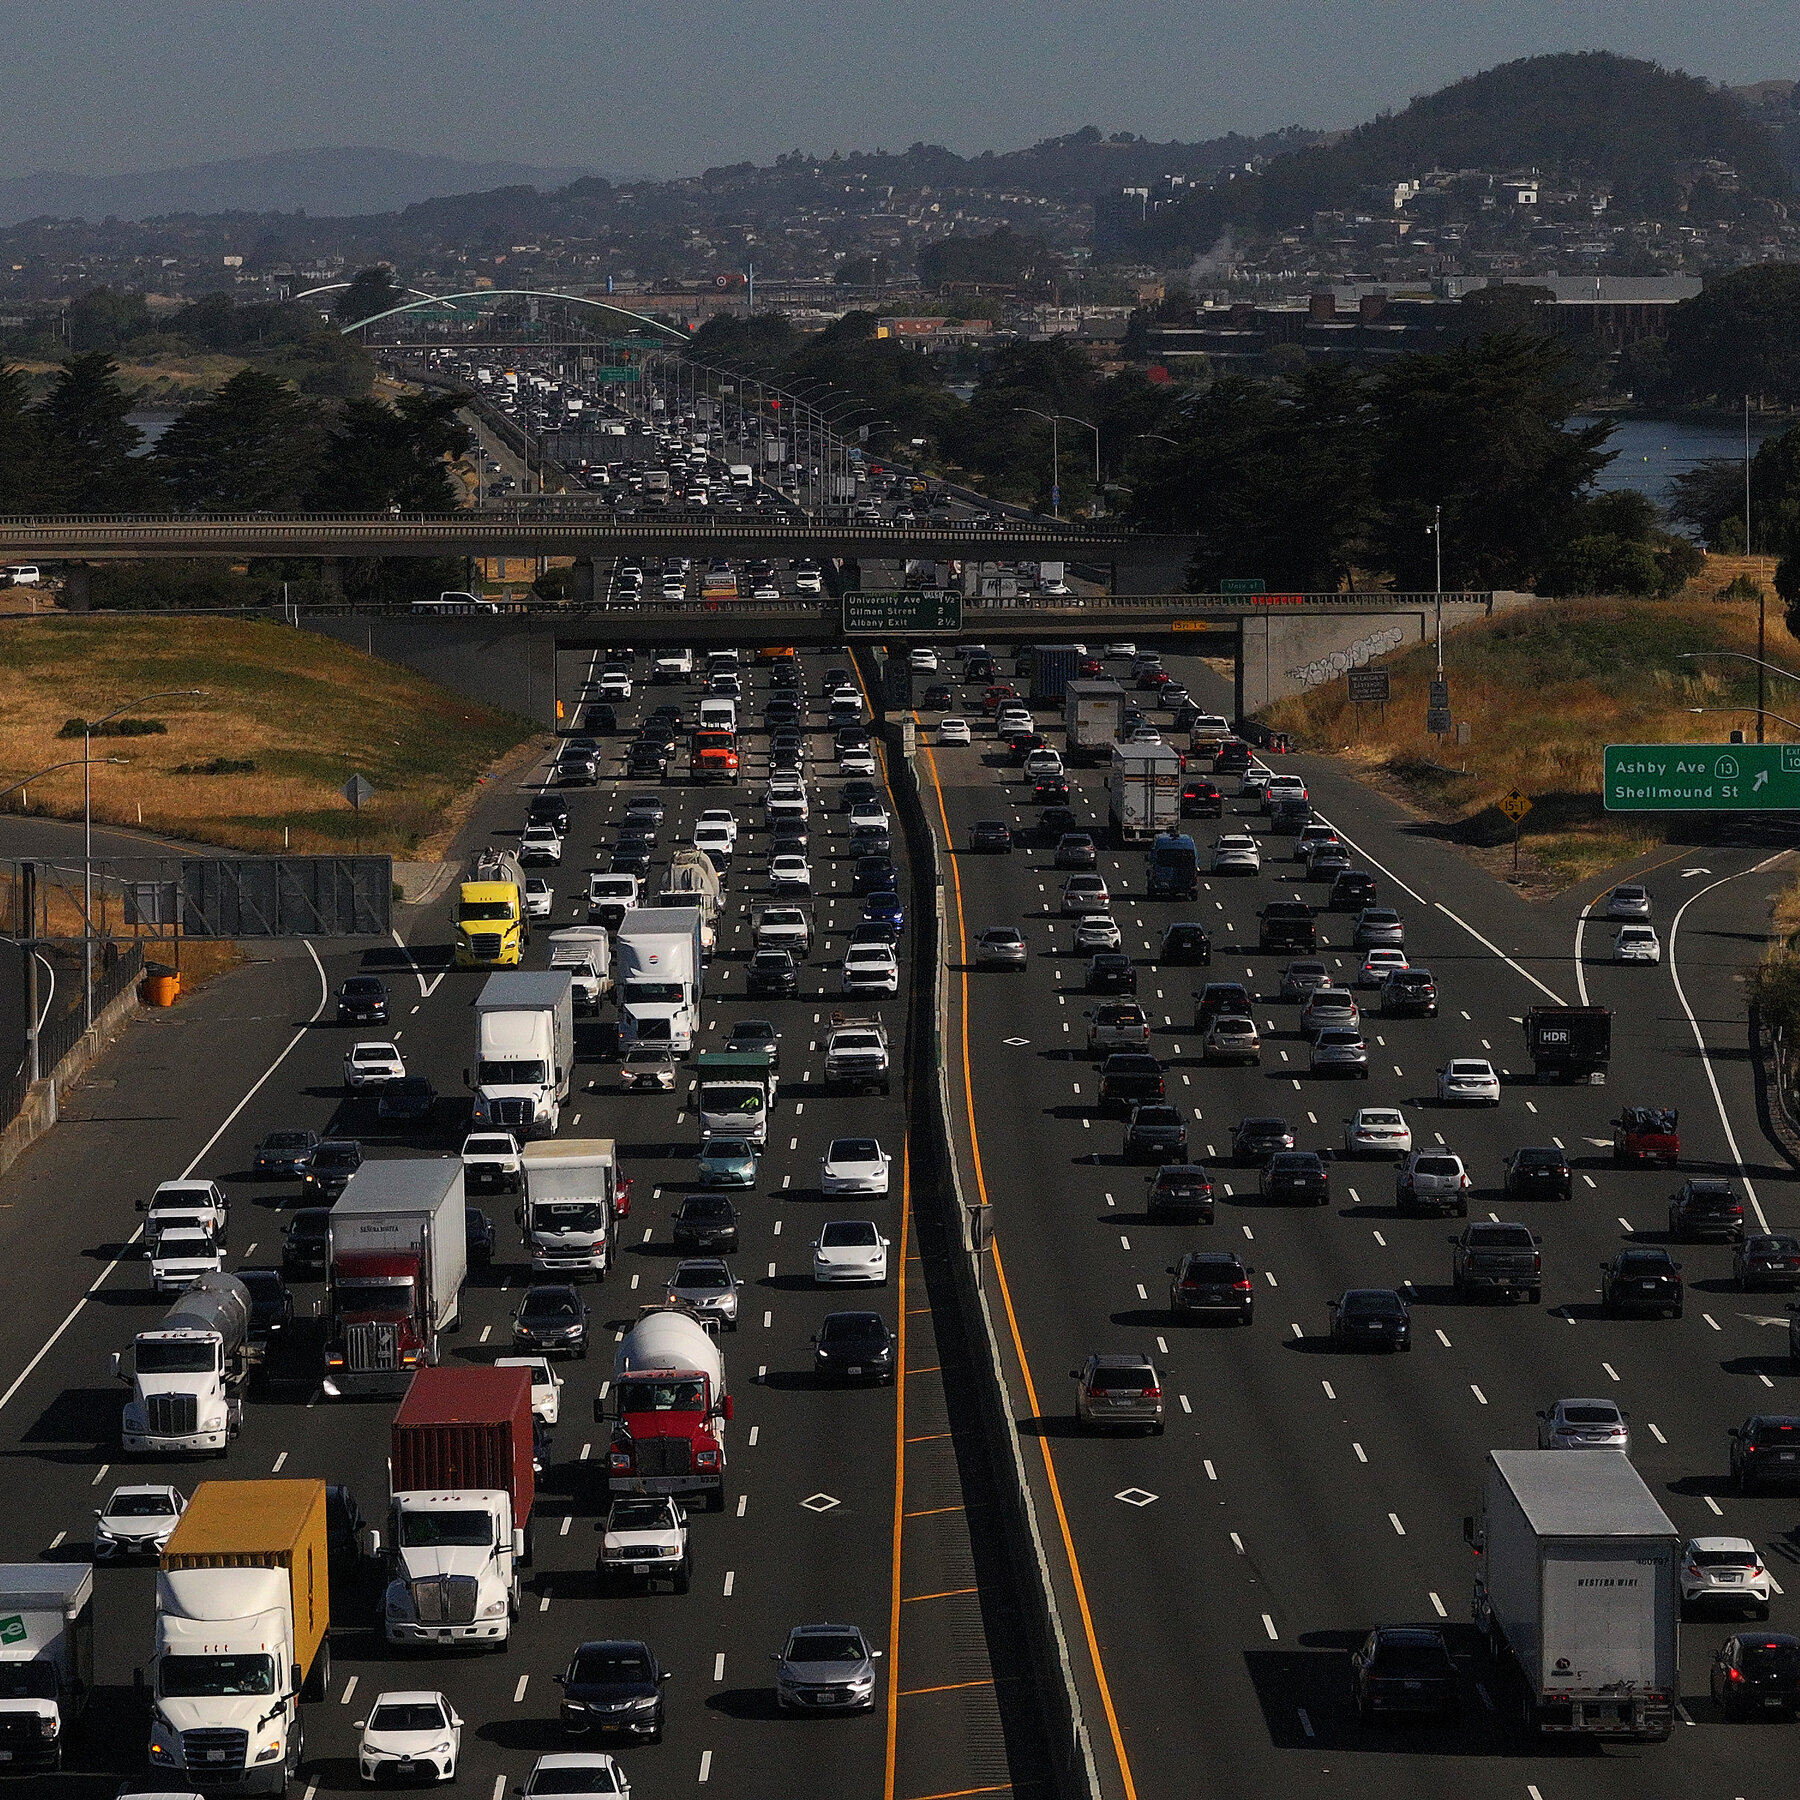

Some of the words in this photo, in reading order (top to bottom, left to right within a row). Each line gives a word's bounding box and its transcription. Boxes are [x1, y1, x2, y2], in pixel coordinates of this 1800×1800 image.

[849, 596, 899, 605] University
[903, 595, 921, 604] Ave
[849, 608, 883, 616] Gilman
[887, 607, 917, 615] Street
[937, 607, 944, 615] 2
[850, 619, 884, 628] Albany
[1615, 761, 1667, 776] Ashby
[1676, 761, 1706, 774] Ave
[1720, 762, 1733, 775] 13
[1615, 786, 1713, 798] Shellmound
[1721, 786, 1739, 798] St
[1543, 1031, 1567, 1041] HDR
[1577, 1579, 1615, 1587] WESTERN
